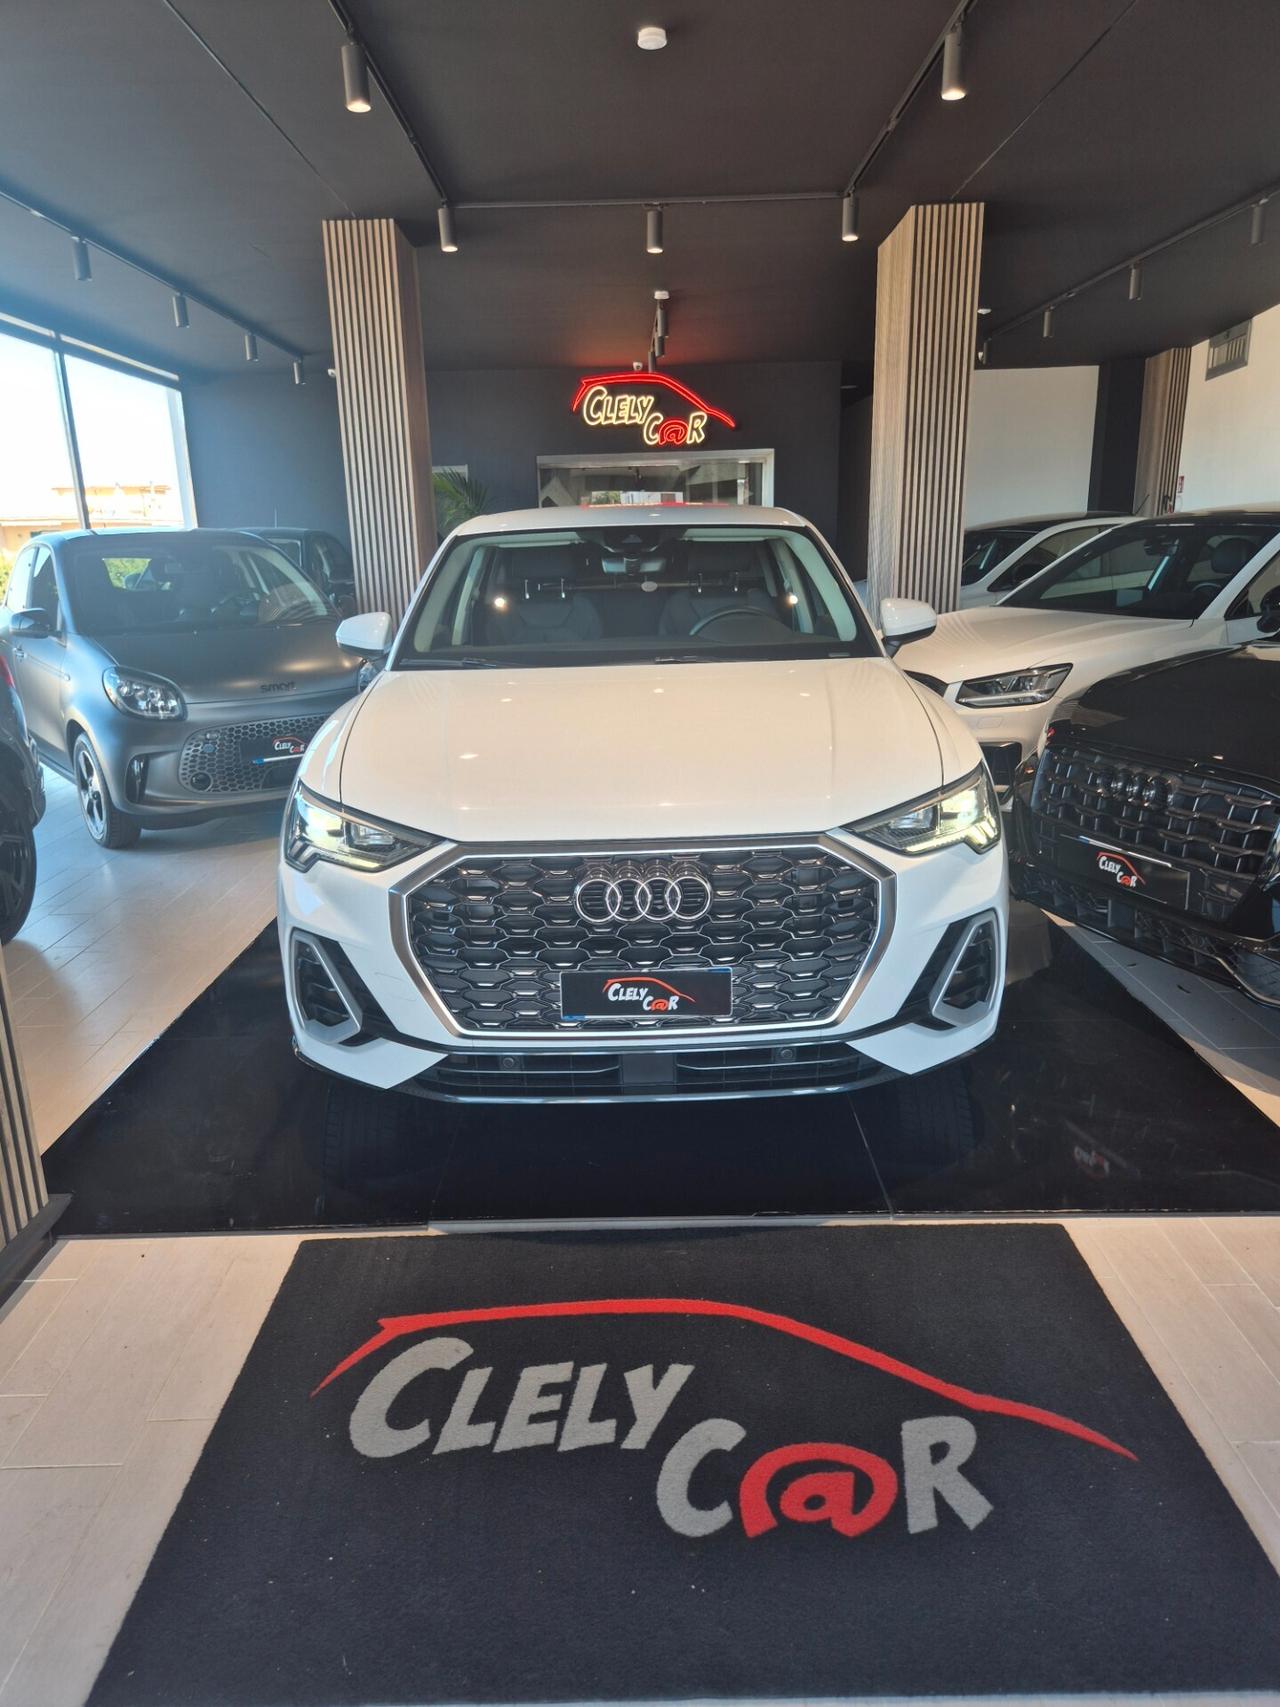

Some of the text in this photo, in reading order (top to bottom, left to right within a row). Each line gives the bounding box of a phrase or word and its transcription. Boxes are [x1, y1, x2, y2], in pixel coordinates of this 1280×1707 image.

[583, 386, 654, 426] CLELY
[643, 412, 707, 446] C@R
[260, 681, 296, 693] smart
[1098, 856, 1121, 874] CLELY
[608, 983, 648, 1002] CLELY
[642, 995, 679, 1011] C@R
[349, 1336, 695, 1458] CLELY
[655, 1415, 994, 1538] C@R
